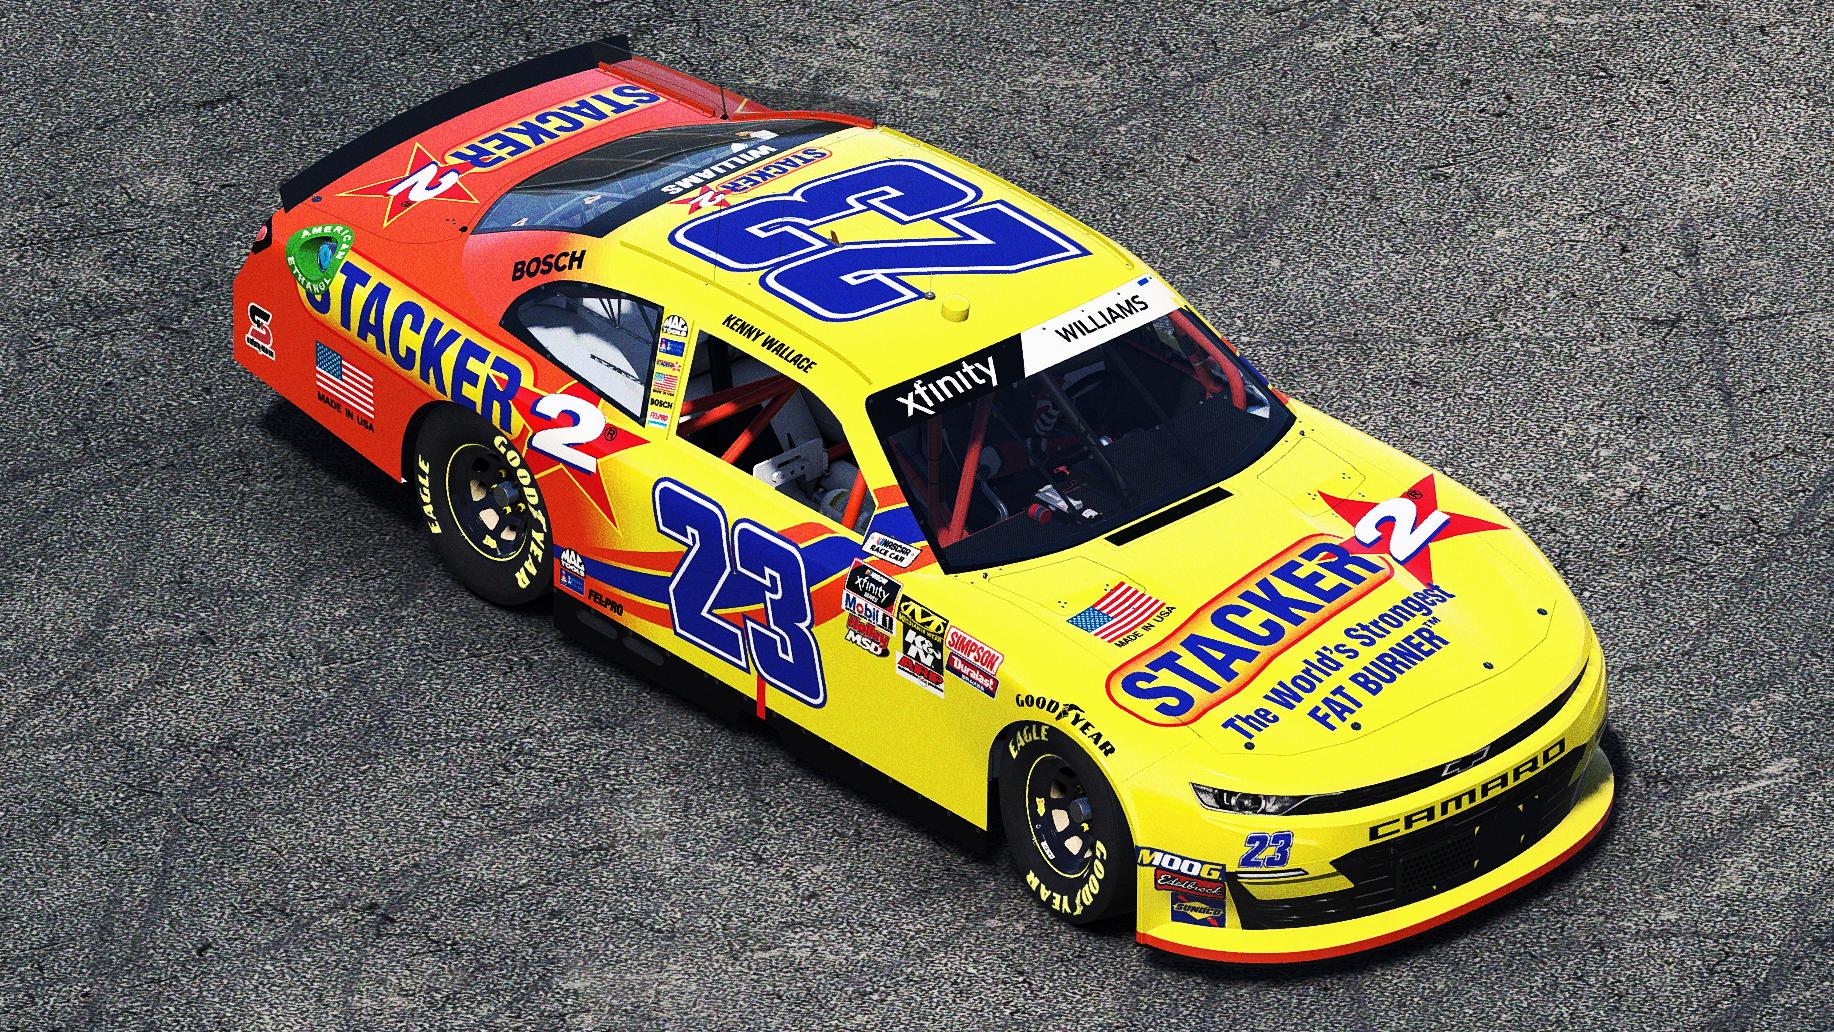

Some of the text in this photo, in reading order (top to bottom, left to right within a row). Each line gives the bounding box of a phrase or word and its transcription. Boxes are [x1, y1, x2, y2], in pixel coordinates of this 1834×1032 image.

[386, 84, 661, 202] STACKER 2
[661, 144, 778, 195] WILLIAMS
[720, 148, 827, 193] STACKER
[301, 225, 352, 260] AMERICAN
[668, 158, 1093, 323] 23
[287, 256, 331, 294] ETHANOL
[512, 250, 585, 282] BOSCH
[663, 315, 688, 331] MAC
[1055, 295, 1149, 343] WILLIAMS
[722, 313, 818, 374] KENNY WALLACE
[650, 398, 674, 409] BOSCH
[896, 356, 999, 418] xfinity
[317, 391, 375, 433] MADE IN USA
[528, 393, 607, 476] 2
[418, 454, 442, 534] EAGLE
[493, 435, 547, 589] GOODYEAR
[870, 544, 905, 563] RACE CAR
[877, 537, 912, 557] NASCAR
[652, 477, 828, 709] 23
[845, 593, 880, 624] Mobil
[855, 575, 890, 603] xfinity
[1120, 497, 1451, 718] STACKER 2
[846, 629, 883, 656] MSD
[1114, 606, 1177, 648] MADE IN USA
[897, 656, 944, 685] ARP
[948, 631, 1000, 671] SIMPSON
[1221, 582, 1456, 740] The World's Strongest
[952, 655, 995, 691] Duralast
[1015, 693, 1116, 758] GOODYEAR
[1307, 685, 1364, 732] FAT
[1009, 723, 1050, 759] EAGLE
[1369, 737, 1567, 843] CAMARO
[1138, 849, 1222, 880] MOOG
[1238, 830, 1294, 870] 23
[1026, 839, 1107, 917] GOODYEAR
[1158, 874, 1223, 896] Edelbrock
[1174, 902, 1223, 917] SUNOCO
